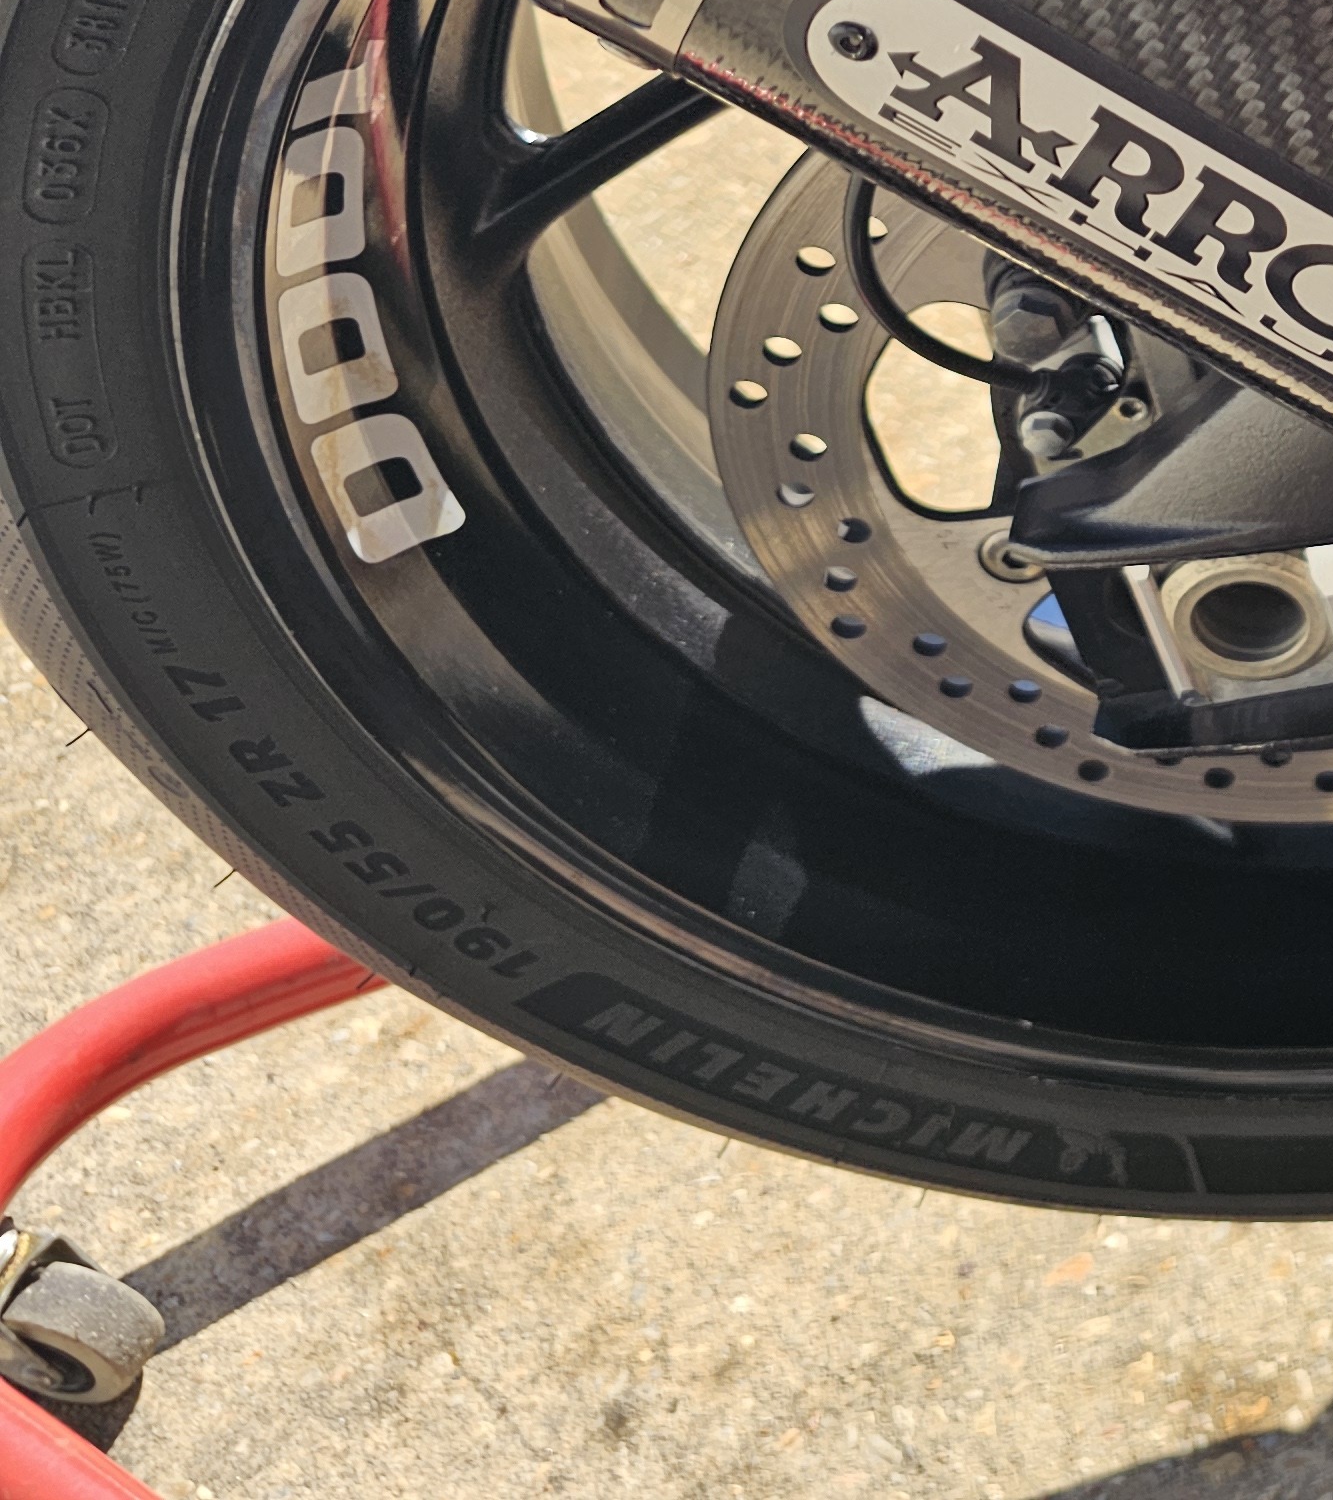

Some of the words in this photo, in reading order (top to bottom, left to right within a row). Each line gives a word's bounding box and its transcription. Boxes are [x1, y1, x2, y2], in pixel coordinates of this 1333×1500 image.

[35, 105, 95, 201] 036X
[34, 249, 83, 341] HBKL
[50, 397, 108, 455] DOT
[162, 664, 247, 723] 17
[228, 734, 327, 808] ZR
[308, 819, 542, 979] 190/55
[581, 1000, 1034, 1165] MICHELIN
